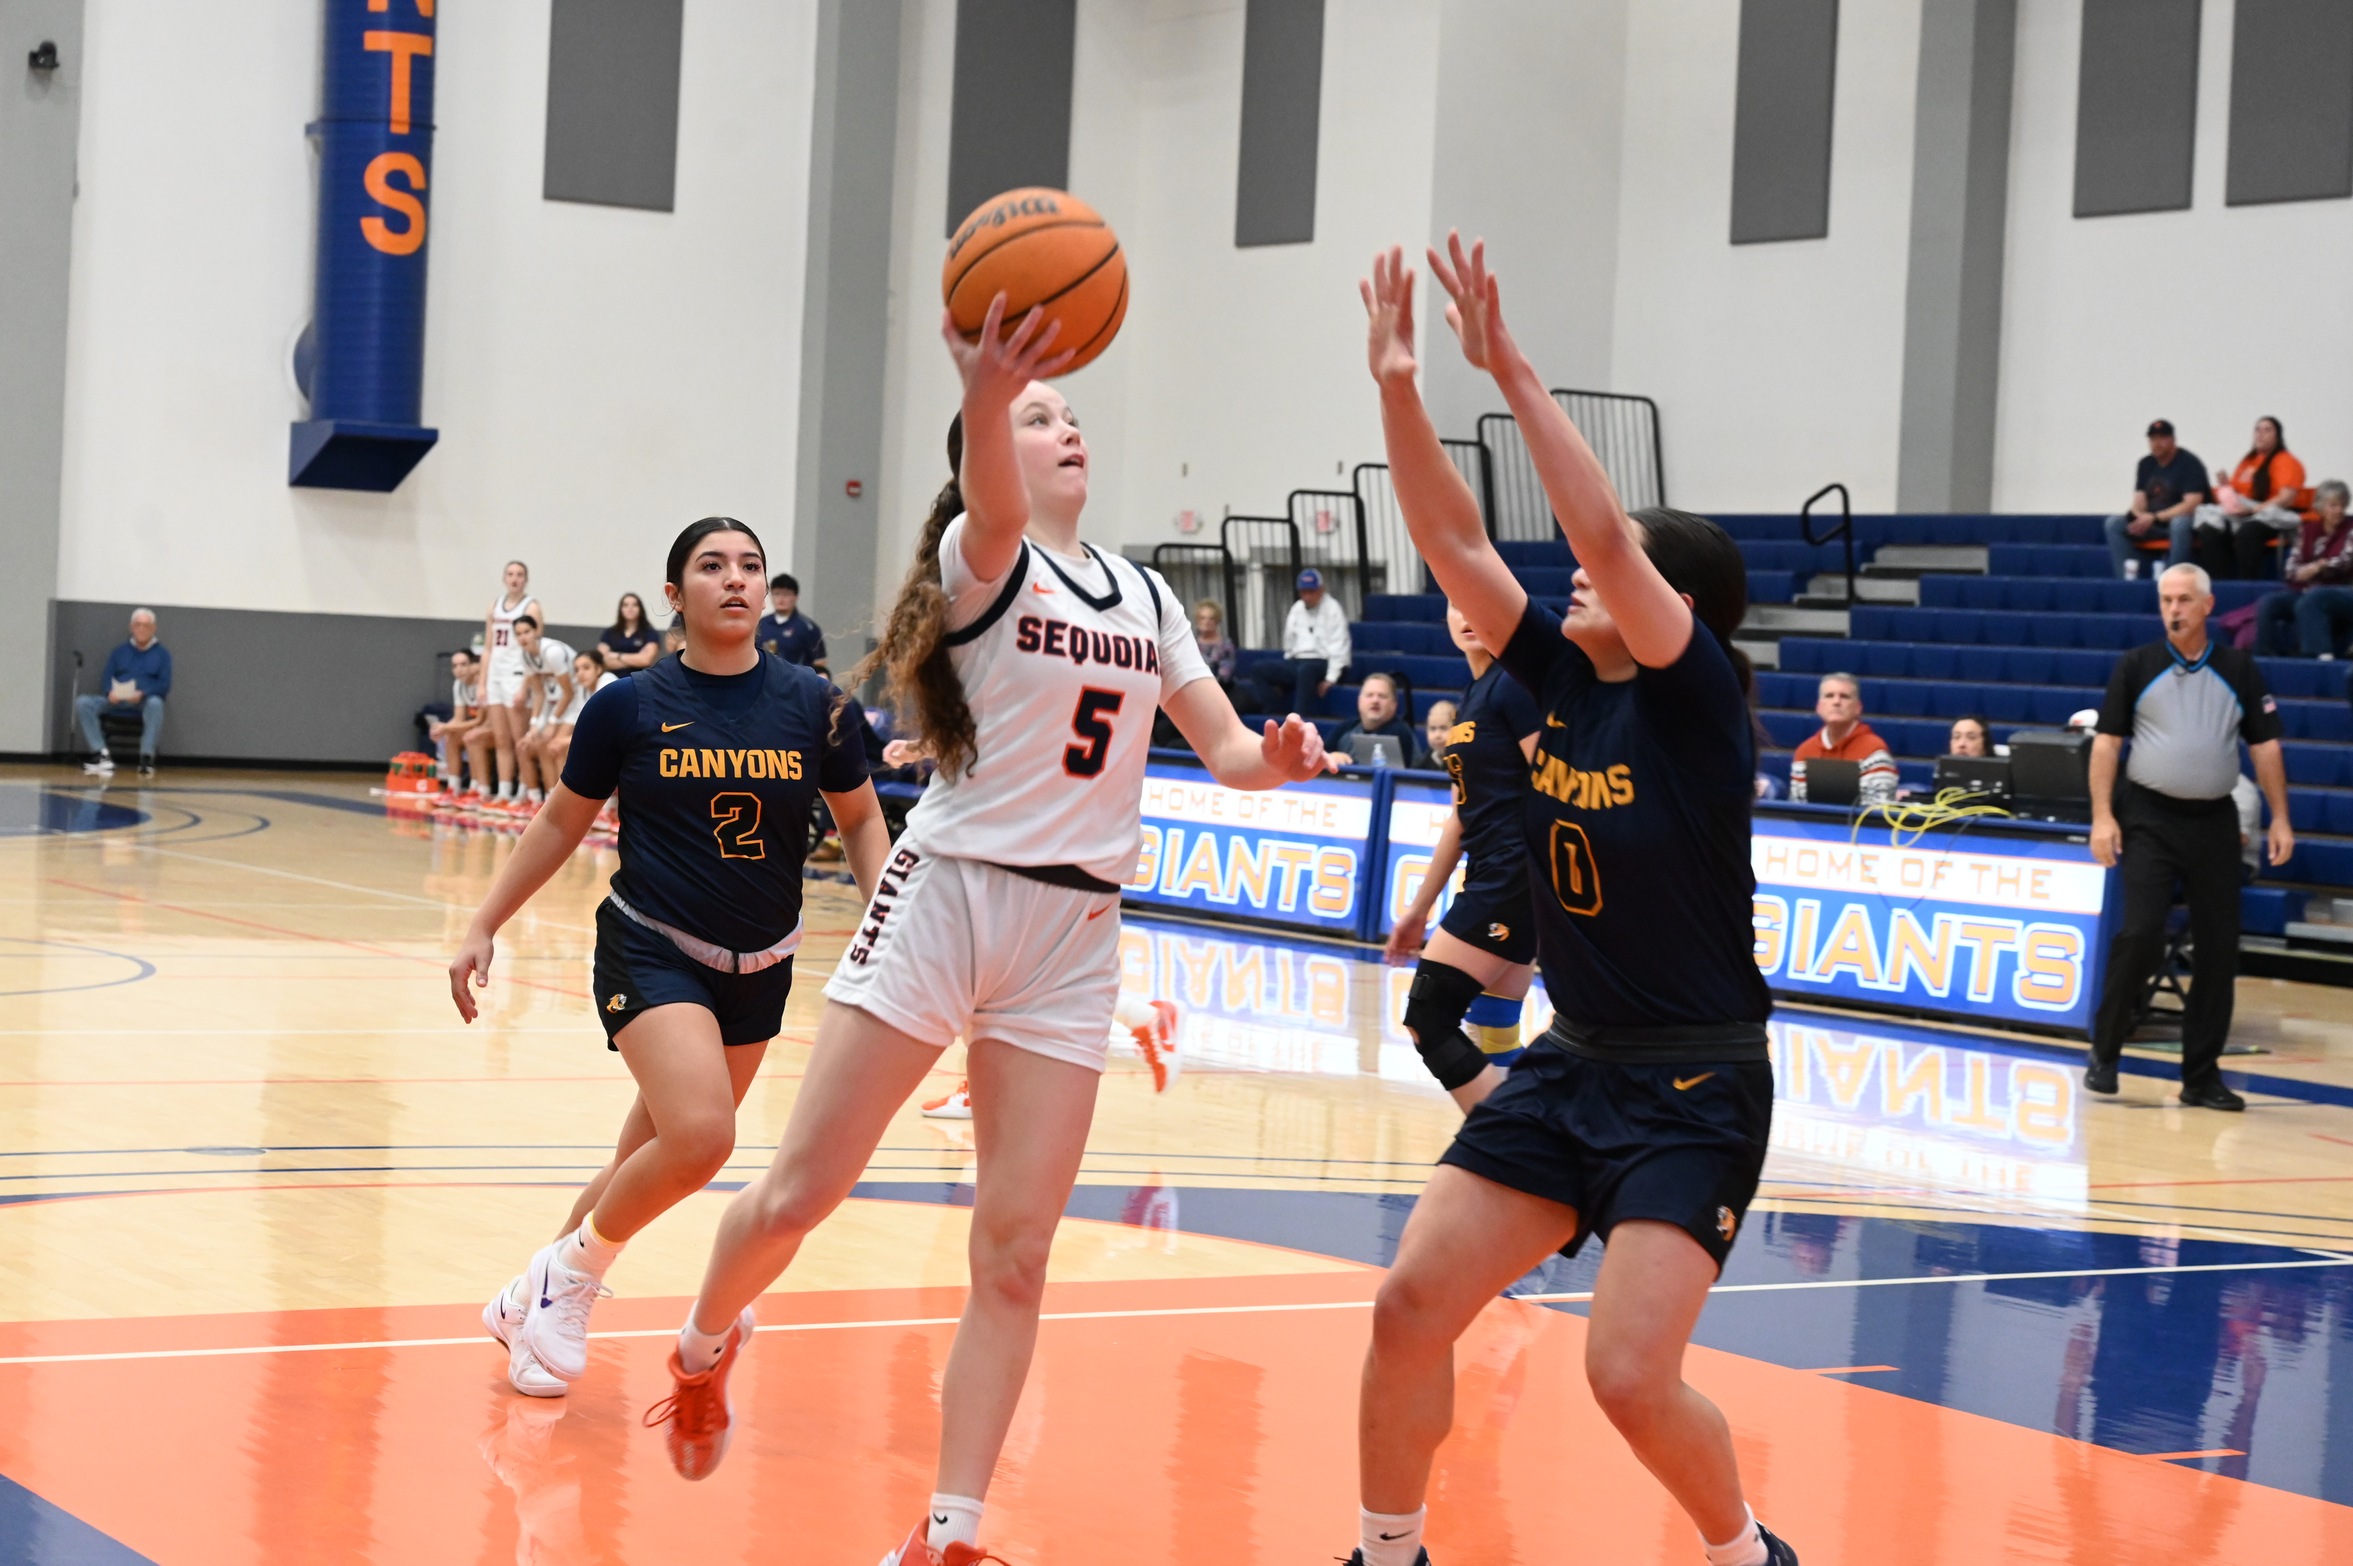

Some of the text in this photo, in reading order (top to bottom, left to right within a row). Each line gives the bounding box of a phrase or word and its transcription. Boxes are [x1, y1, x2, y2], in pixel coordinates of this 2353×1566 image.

[360, 0, 435, 256] TS
[1016, 615, 1160, 676] SEQUOIA
[659, 748, 803, 780] CANYONS
[1062, 684, 1126, 780] 5
[710, 791, 765, 860] 2
[1149, 785, 1337, 828] HOME OF THE
[1550, 818, 1603, 917] 0
[1766, 845, 2052, 900] HOME OF THE
[849, 848, 920, 966] GIANTS
